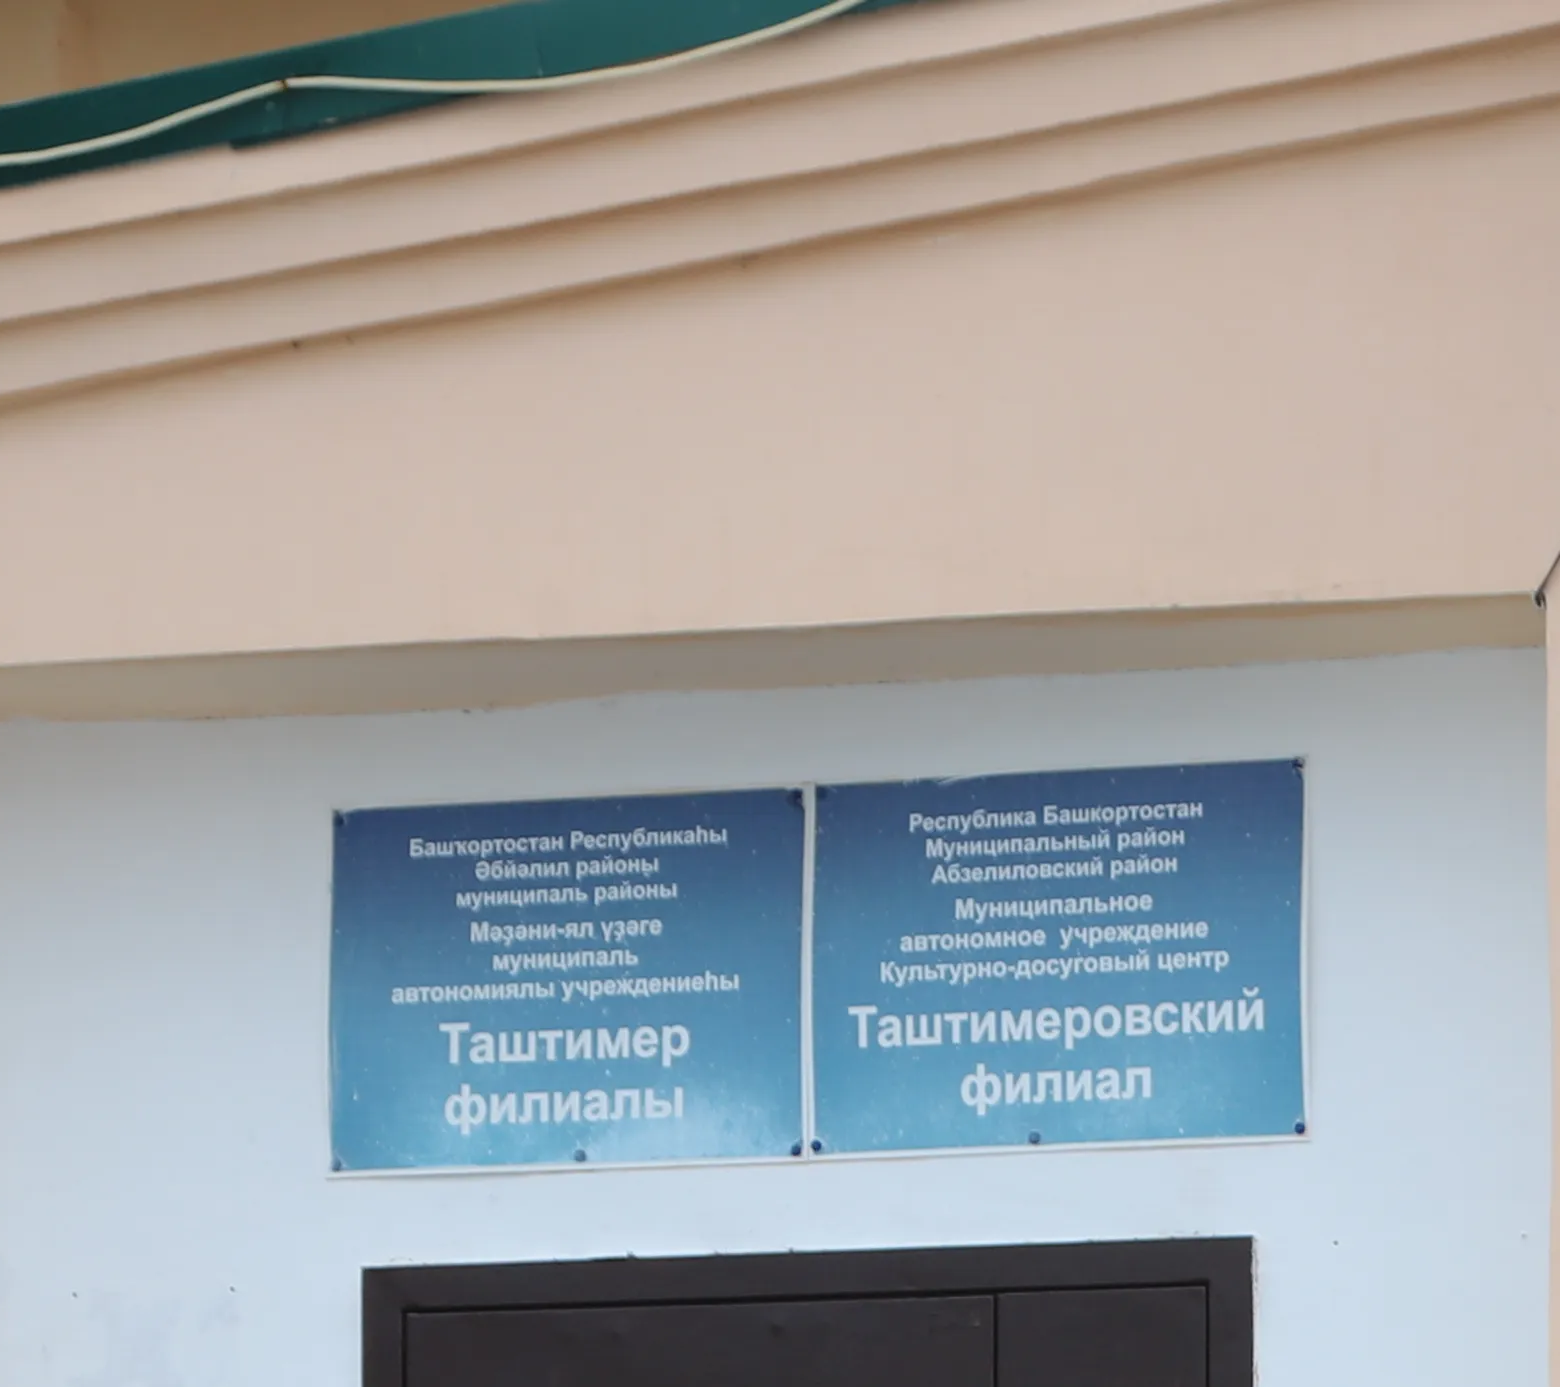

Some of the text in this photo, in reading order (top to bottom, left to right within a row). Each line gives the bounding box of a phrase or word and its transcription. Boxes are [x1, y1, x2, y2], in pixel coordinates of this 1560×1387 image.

[909, 800, 1204, 835] Республика Башкортостан
[409, 825, 728, 857] Башҡортостан Республикаһы
[925, 827, 1185, 861] Муниципальный район
[475, 855, 659, 881] Әбйәлил районы
[931, 854, 1178, 885] Абзелиловский район
[456, 881, 678, 910] муниципаль районы
[954, 894, 1153, 924] Муниципальное
[899, 919, 1209, 953] автономное учреждение
[492, 948, 639, 975] муниципаль
[880, 949, 1230, 987] Культурно-досуговый центр
[391, 969, 740, 1004] автономиялы учреждениеһы
[848, 987, 1265, 1050] Таштимеровский
[438, 1022, 690, 1067] Таштимер
[960, 1063, 1152, 1116] филиал
[444, 1083, 684, 1135] филиалы
